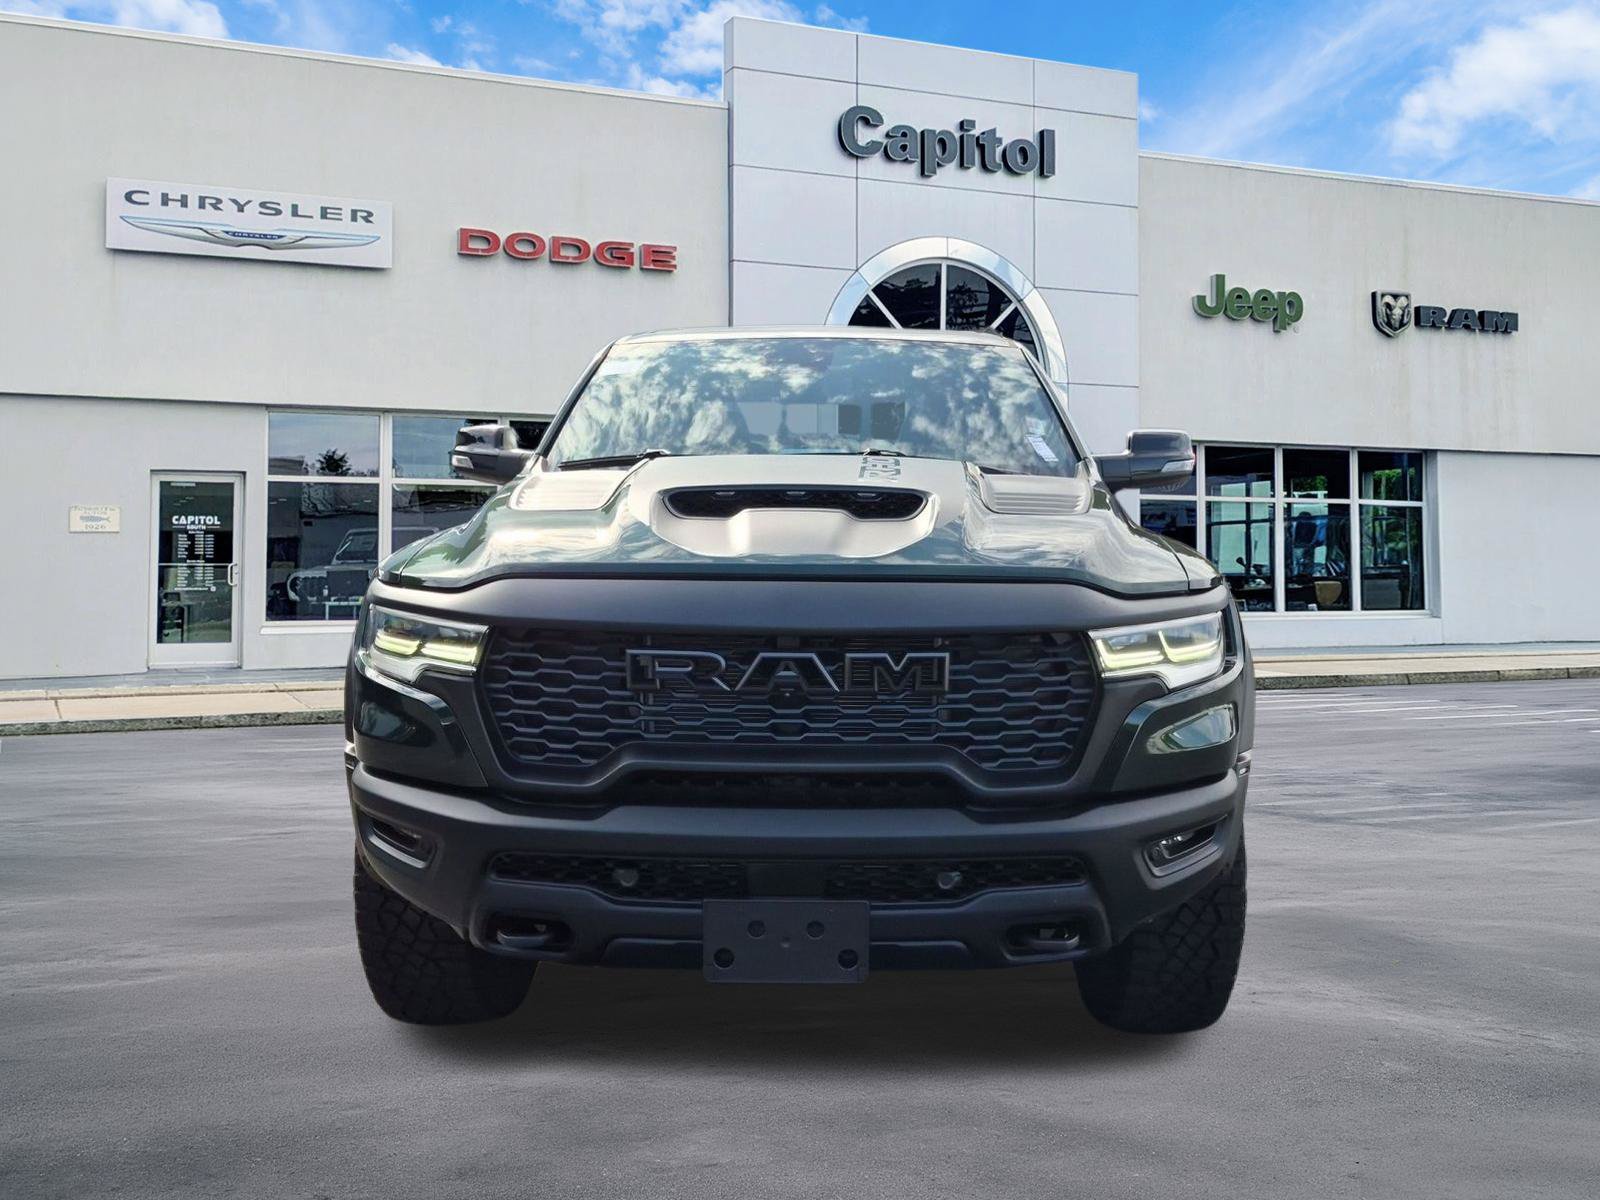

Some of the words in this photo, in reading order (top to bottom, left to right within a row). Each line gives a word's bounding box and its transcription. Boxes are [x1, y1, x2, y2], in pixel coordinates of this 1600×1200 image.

[838, 105, 1056, 178] Capitol
[124, 189, 375, 224] CHRYSLER
[457, 227, 678, 273] DODGE
[1192, 273, 1304, 333] Jeep
[1414, 305, 1519, 333] RAM
[172, 515, 221, 525] CAPITOL
[625, 649, 951, 693] RAM
